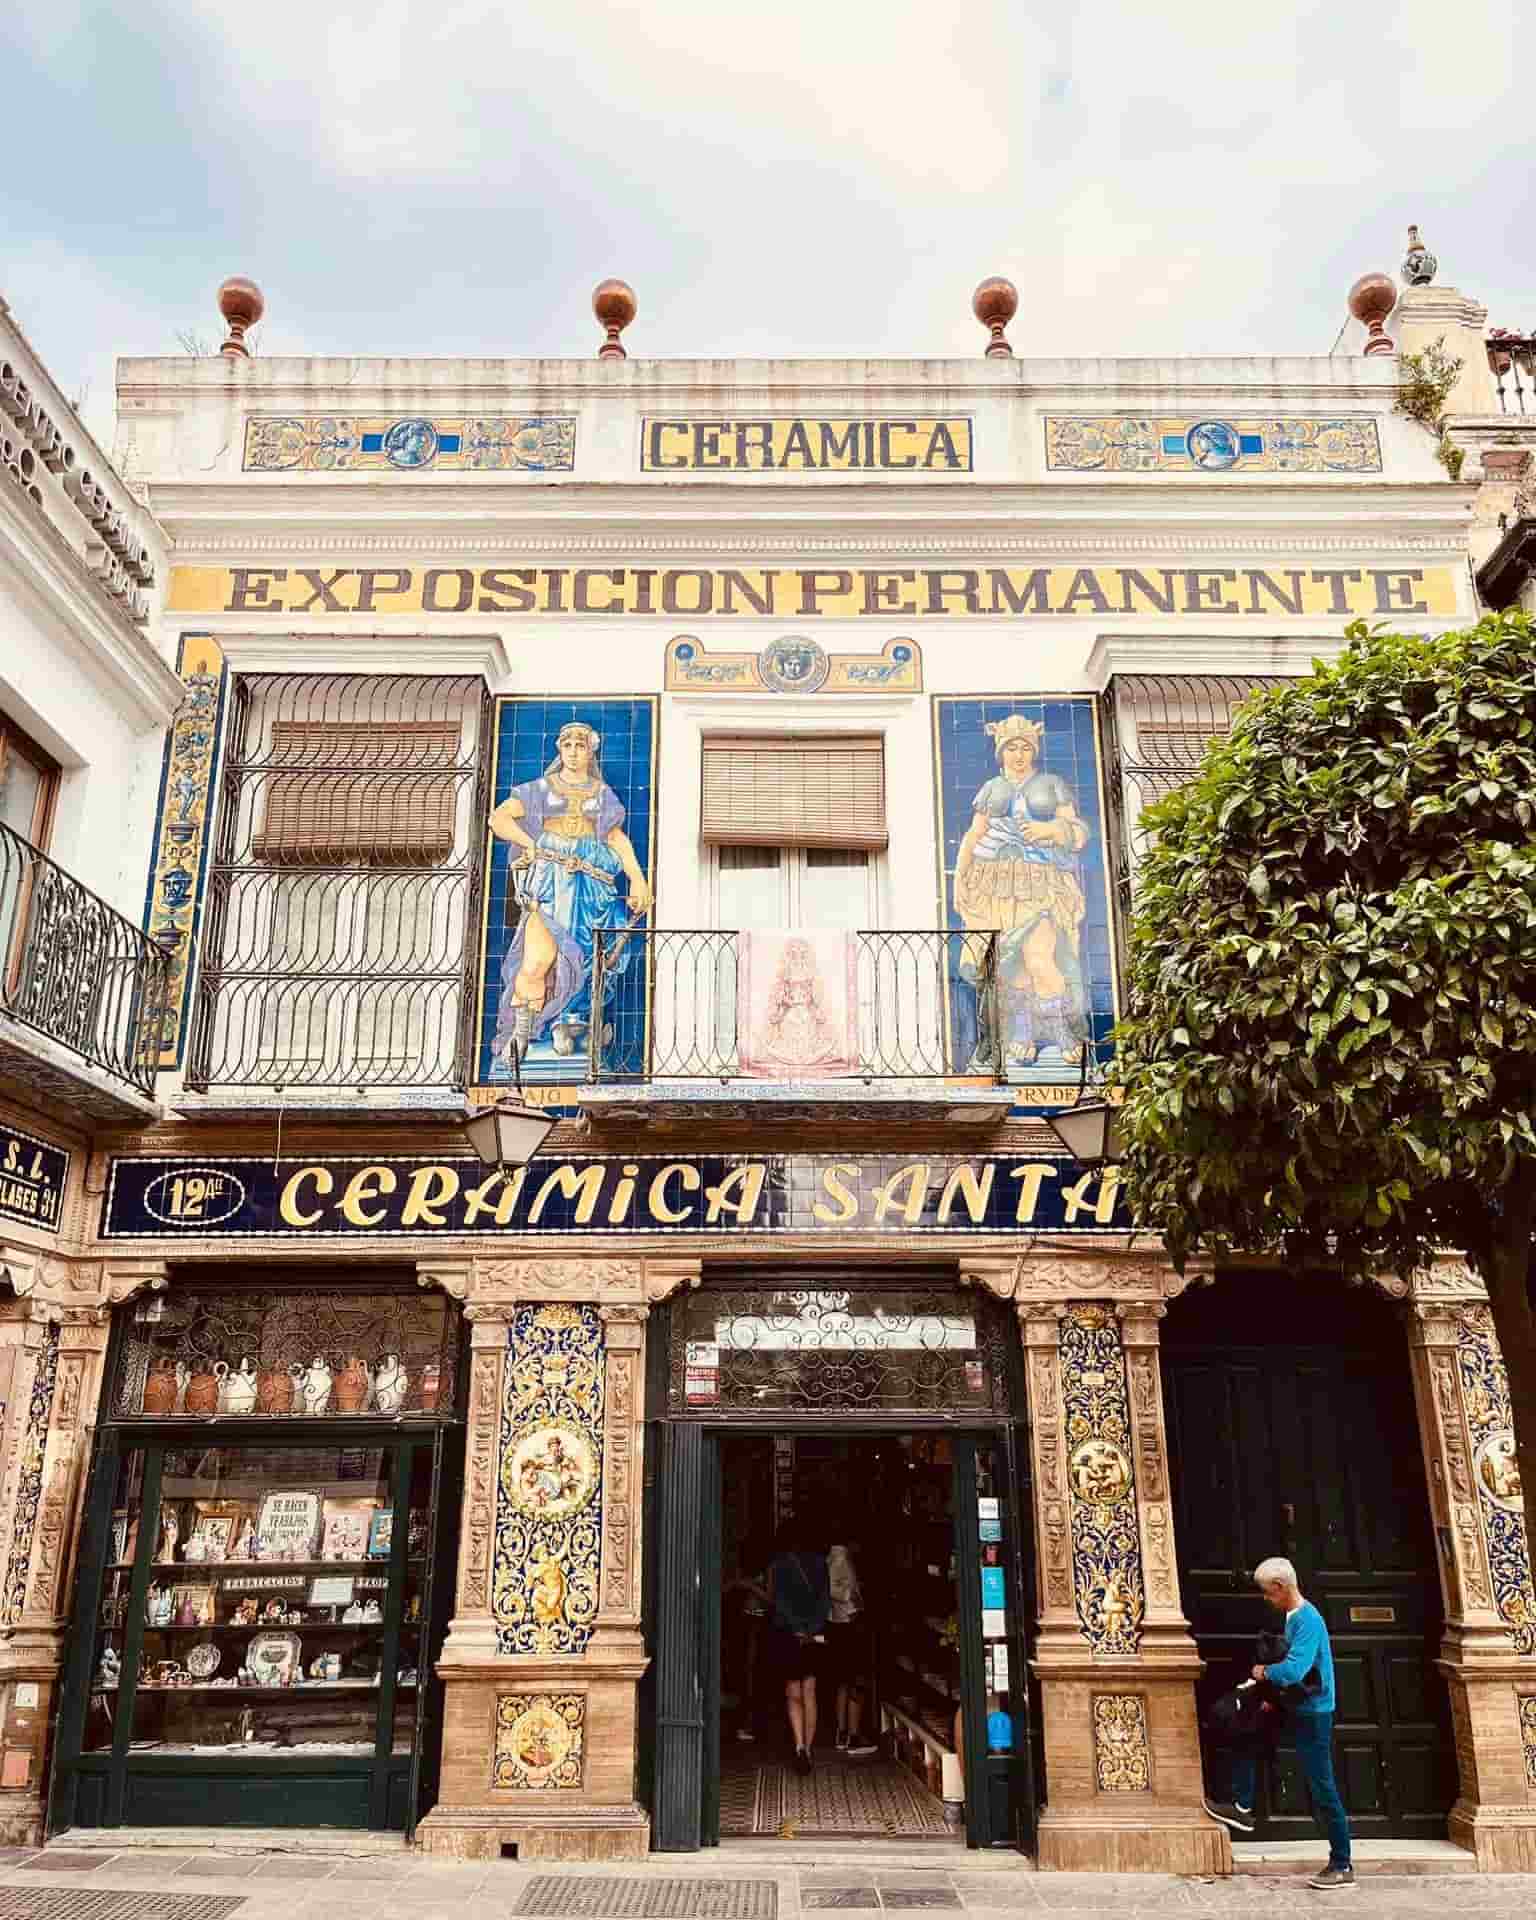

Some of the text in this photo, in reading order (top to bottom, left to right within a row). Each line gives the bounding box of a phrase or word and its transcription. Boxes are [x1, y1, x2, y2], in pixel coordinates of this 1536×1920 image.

[650, 422, 962, 468] CERAMICA
[223, 567, 1427, 615] EXPOSICION PERMANENTE
[812, 1162, 1122, 1225] SANTA
